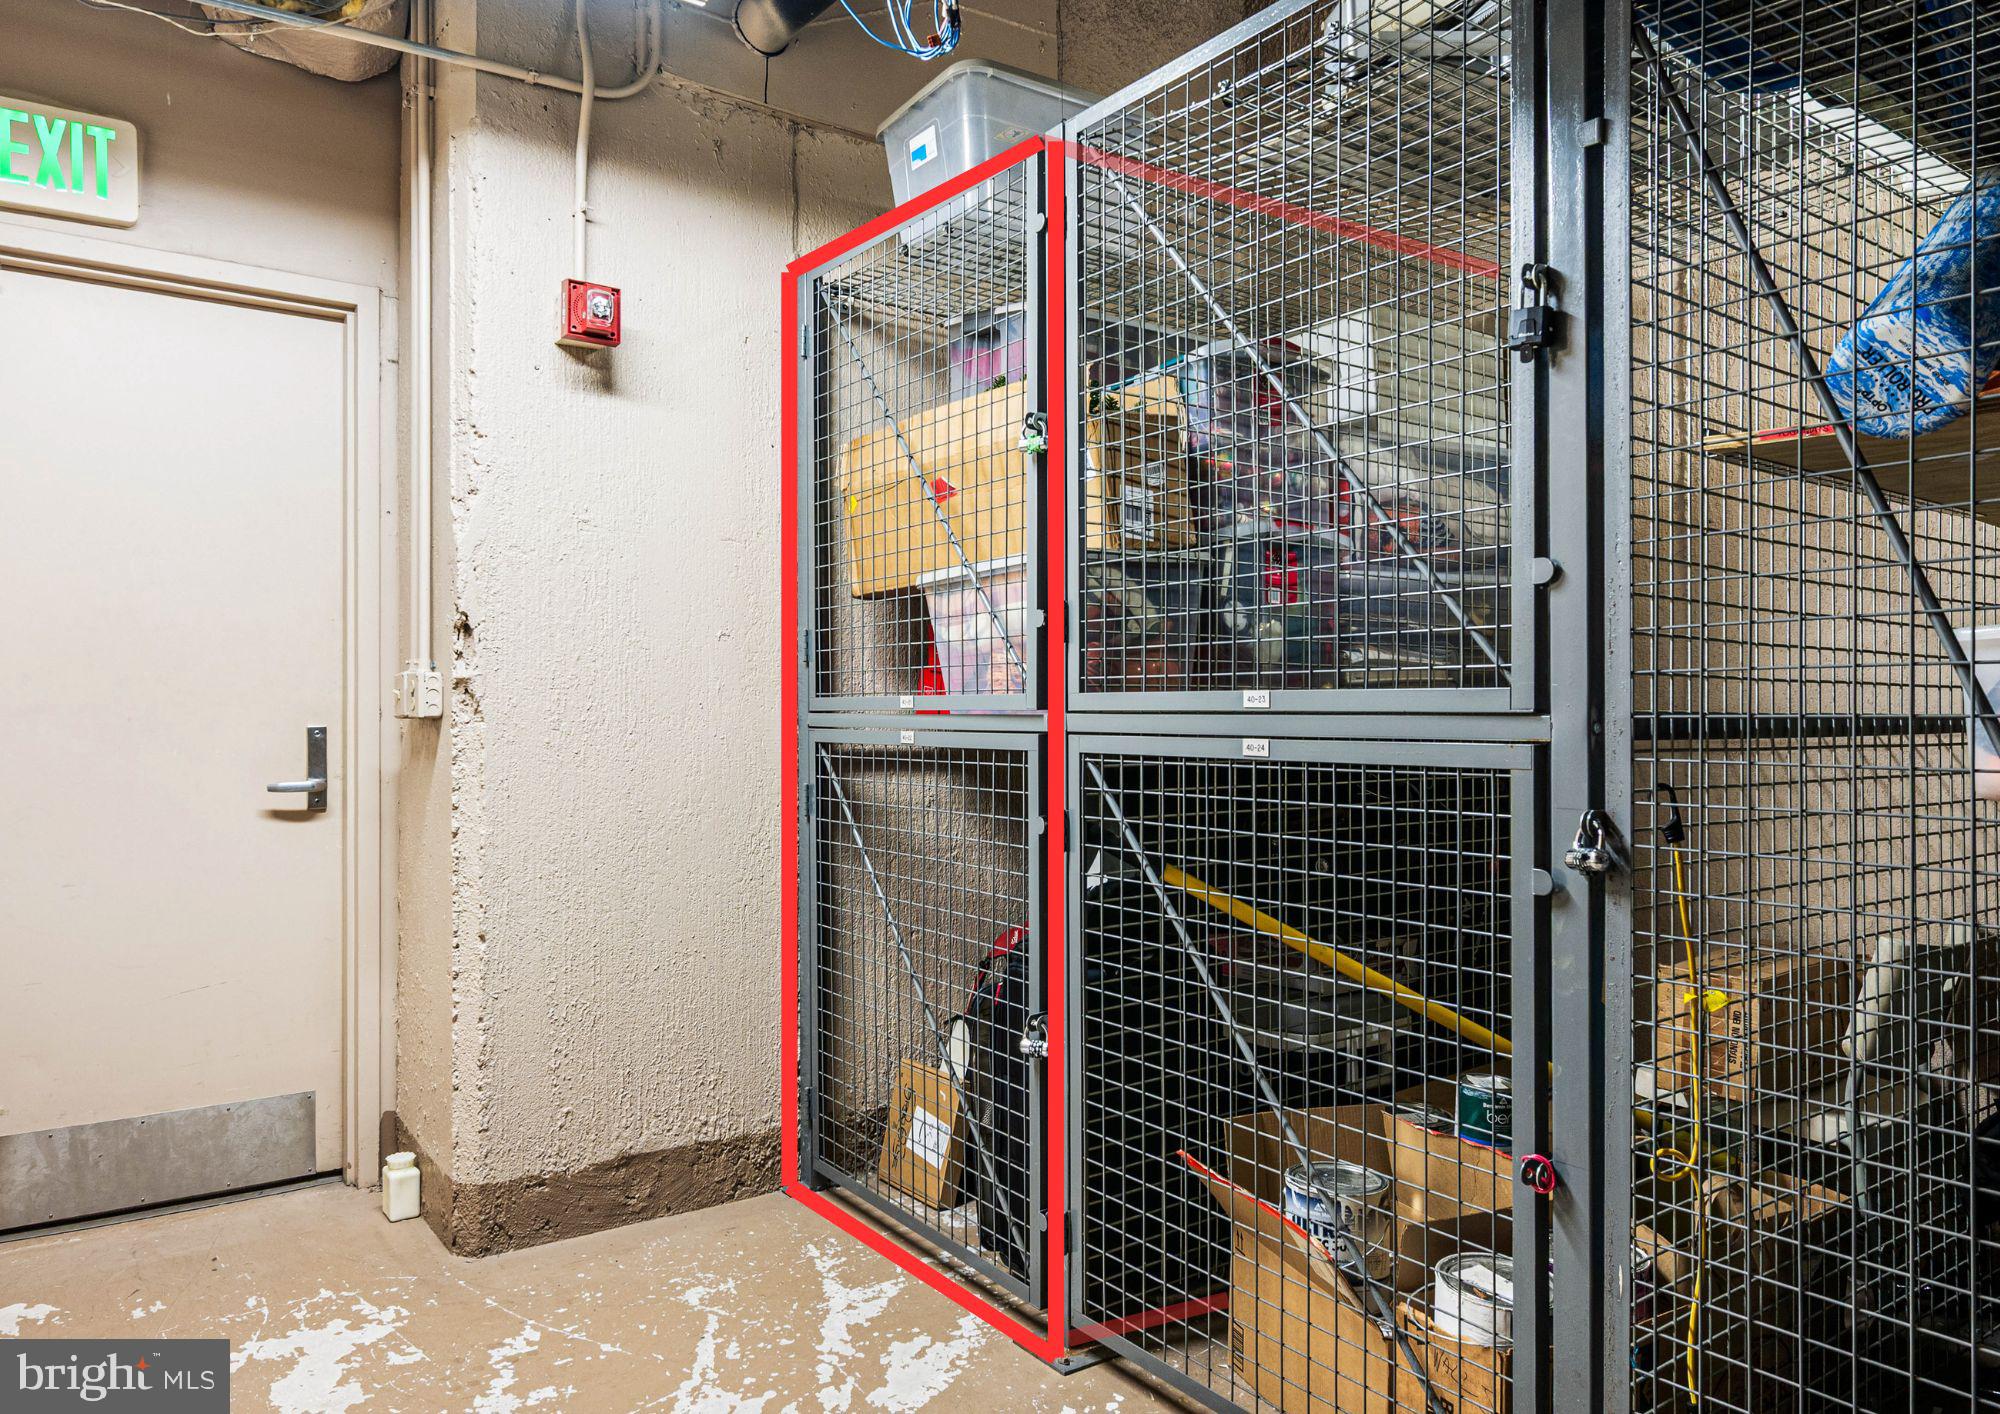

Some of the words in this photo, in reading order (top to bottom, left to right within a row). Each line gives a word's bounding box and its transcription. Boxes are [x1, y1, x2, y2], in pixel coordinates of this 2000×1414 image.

[0, 107, 116, 200] EXIT
[1247, 695, 1266, 704] 40-23
[1246, 743, 1265, 753] 40-24
